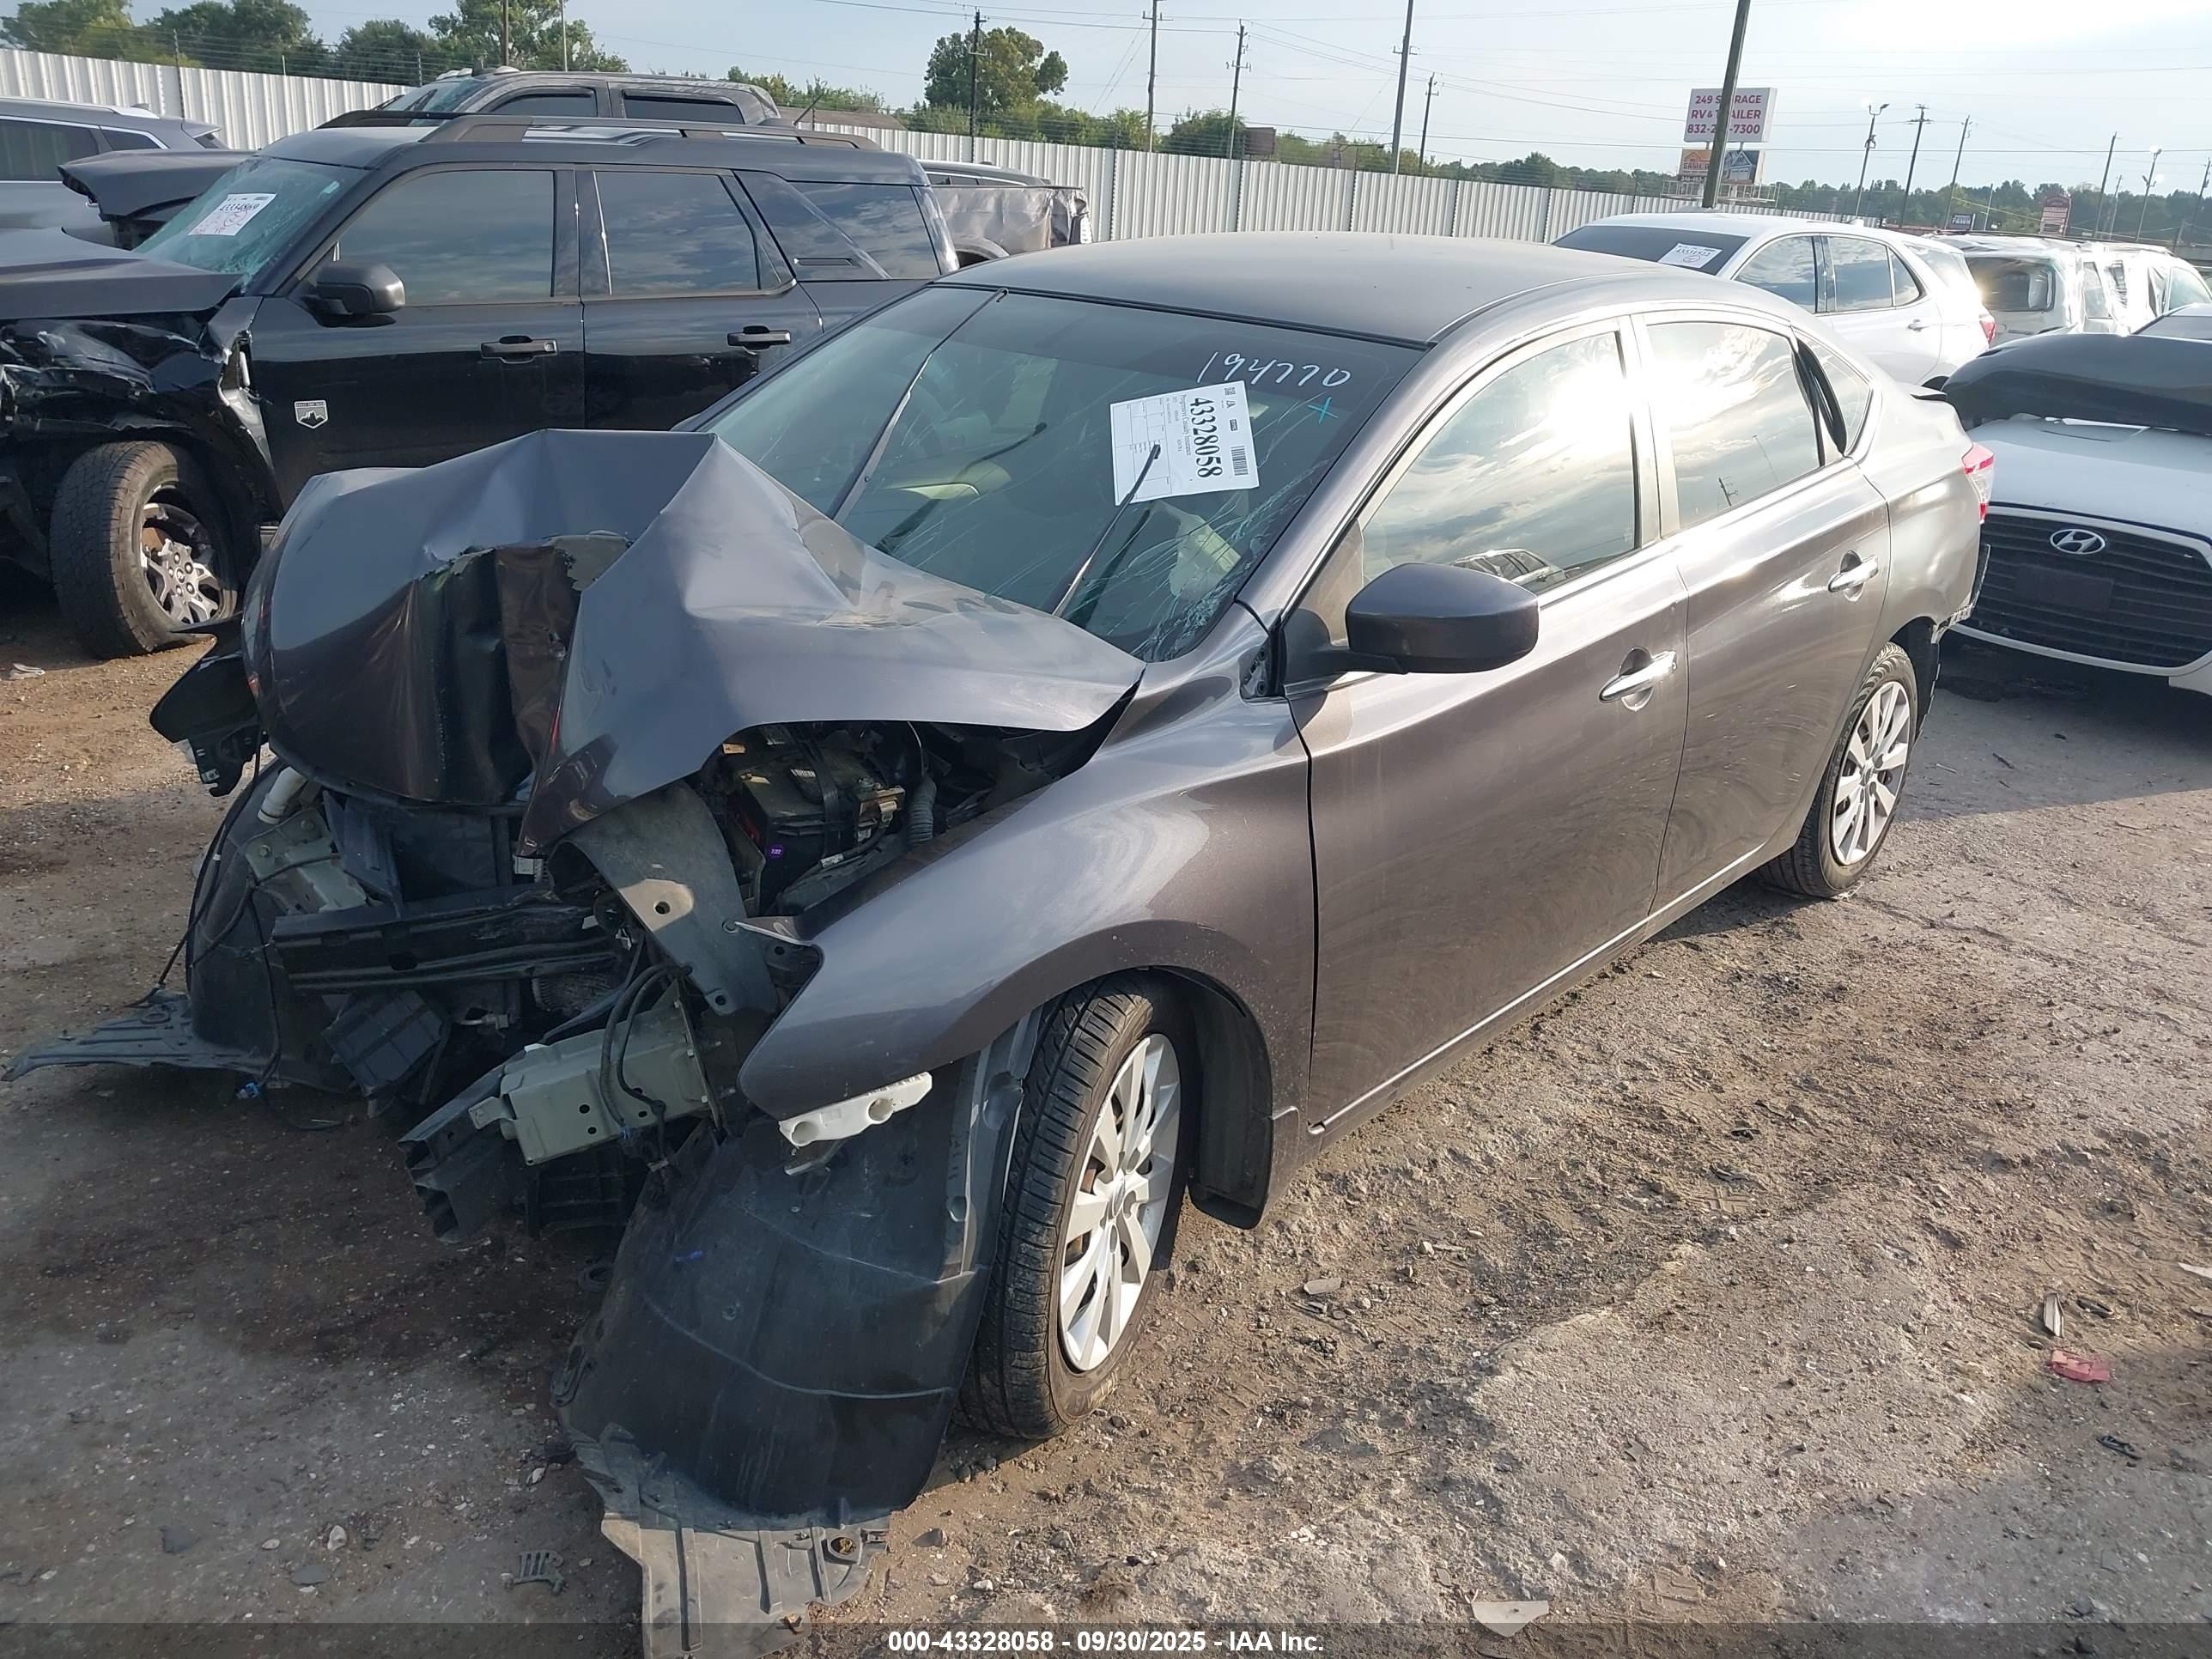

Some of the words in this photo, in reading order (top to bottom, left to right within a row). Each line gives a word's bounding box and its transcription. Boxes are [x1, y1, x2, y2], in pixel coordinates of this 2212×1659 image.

[1695, 95, 1713, 105] 249
[1715, 94, 1762, 104] SRAGE
[1691, 109, 1707, 119] RV
[1707, 110, 1713, 118] &
[1687, 124, 1760, 133] 832-2-7300
[1196, 350, 1352, 388] 194770
[1189, 398, 1223, 477] 43328058
